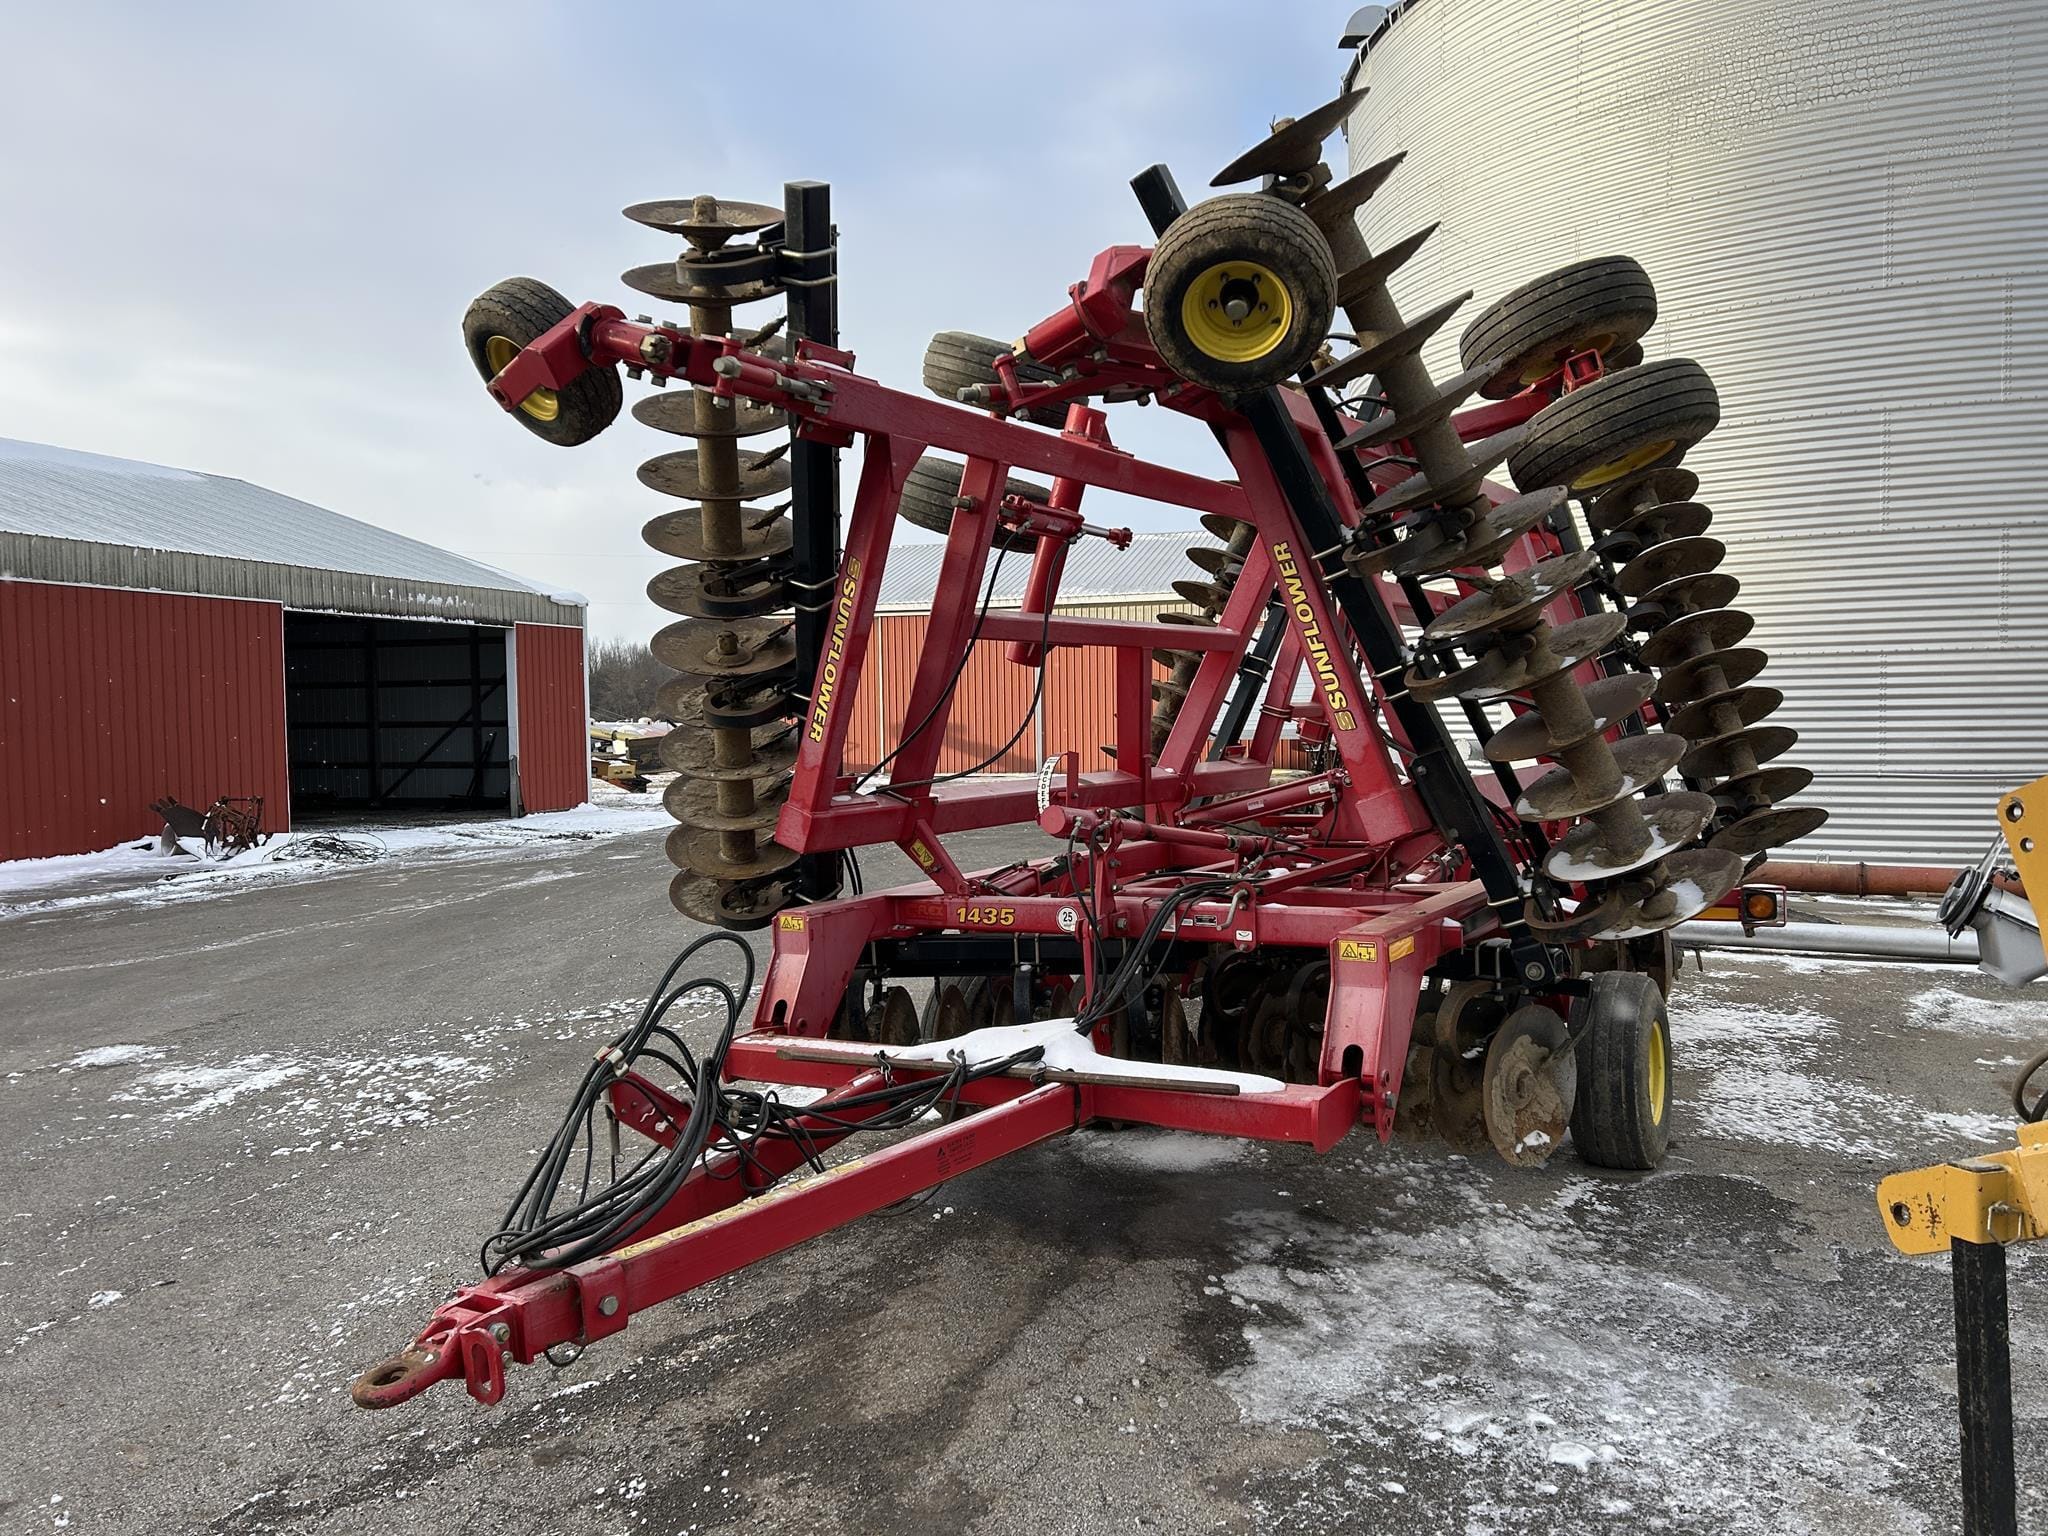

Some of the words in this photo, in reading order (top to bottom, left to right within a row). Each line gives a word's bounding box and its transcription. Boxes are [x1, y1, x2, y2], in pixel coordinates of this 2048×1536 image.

[808, 577, 857, 744] SUNFLOWER
[1273, 540, 1349, 712] SUNFLOWER
[956, 906, 1016, 926] 1435
[1062, 911, 1073, 922] 25
